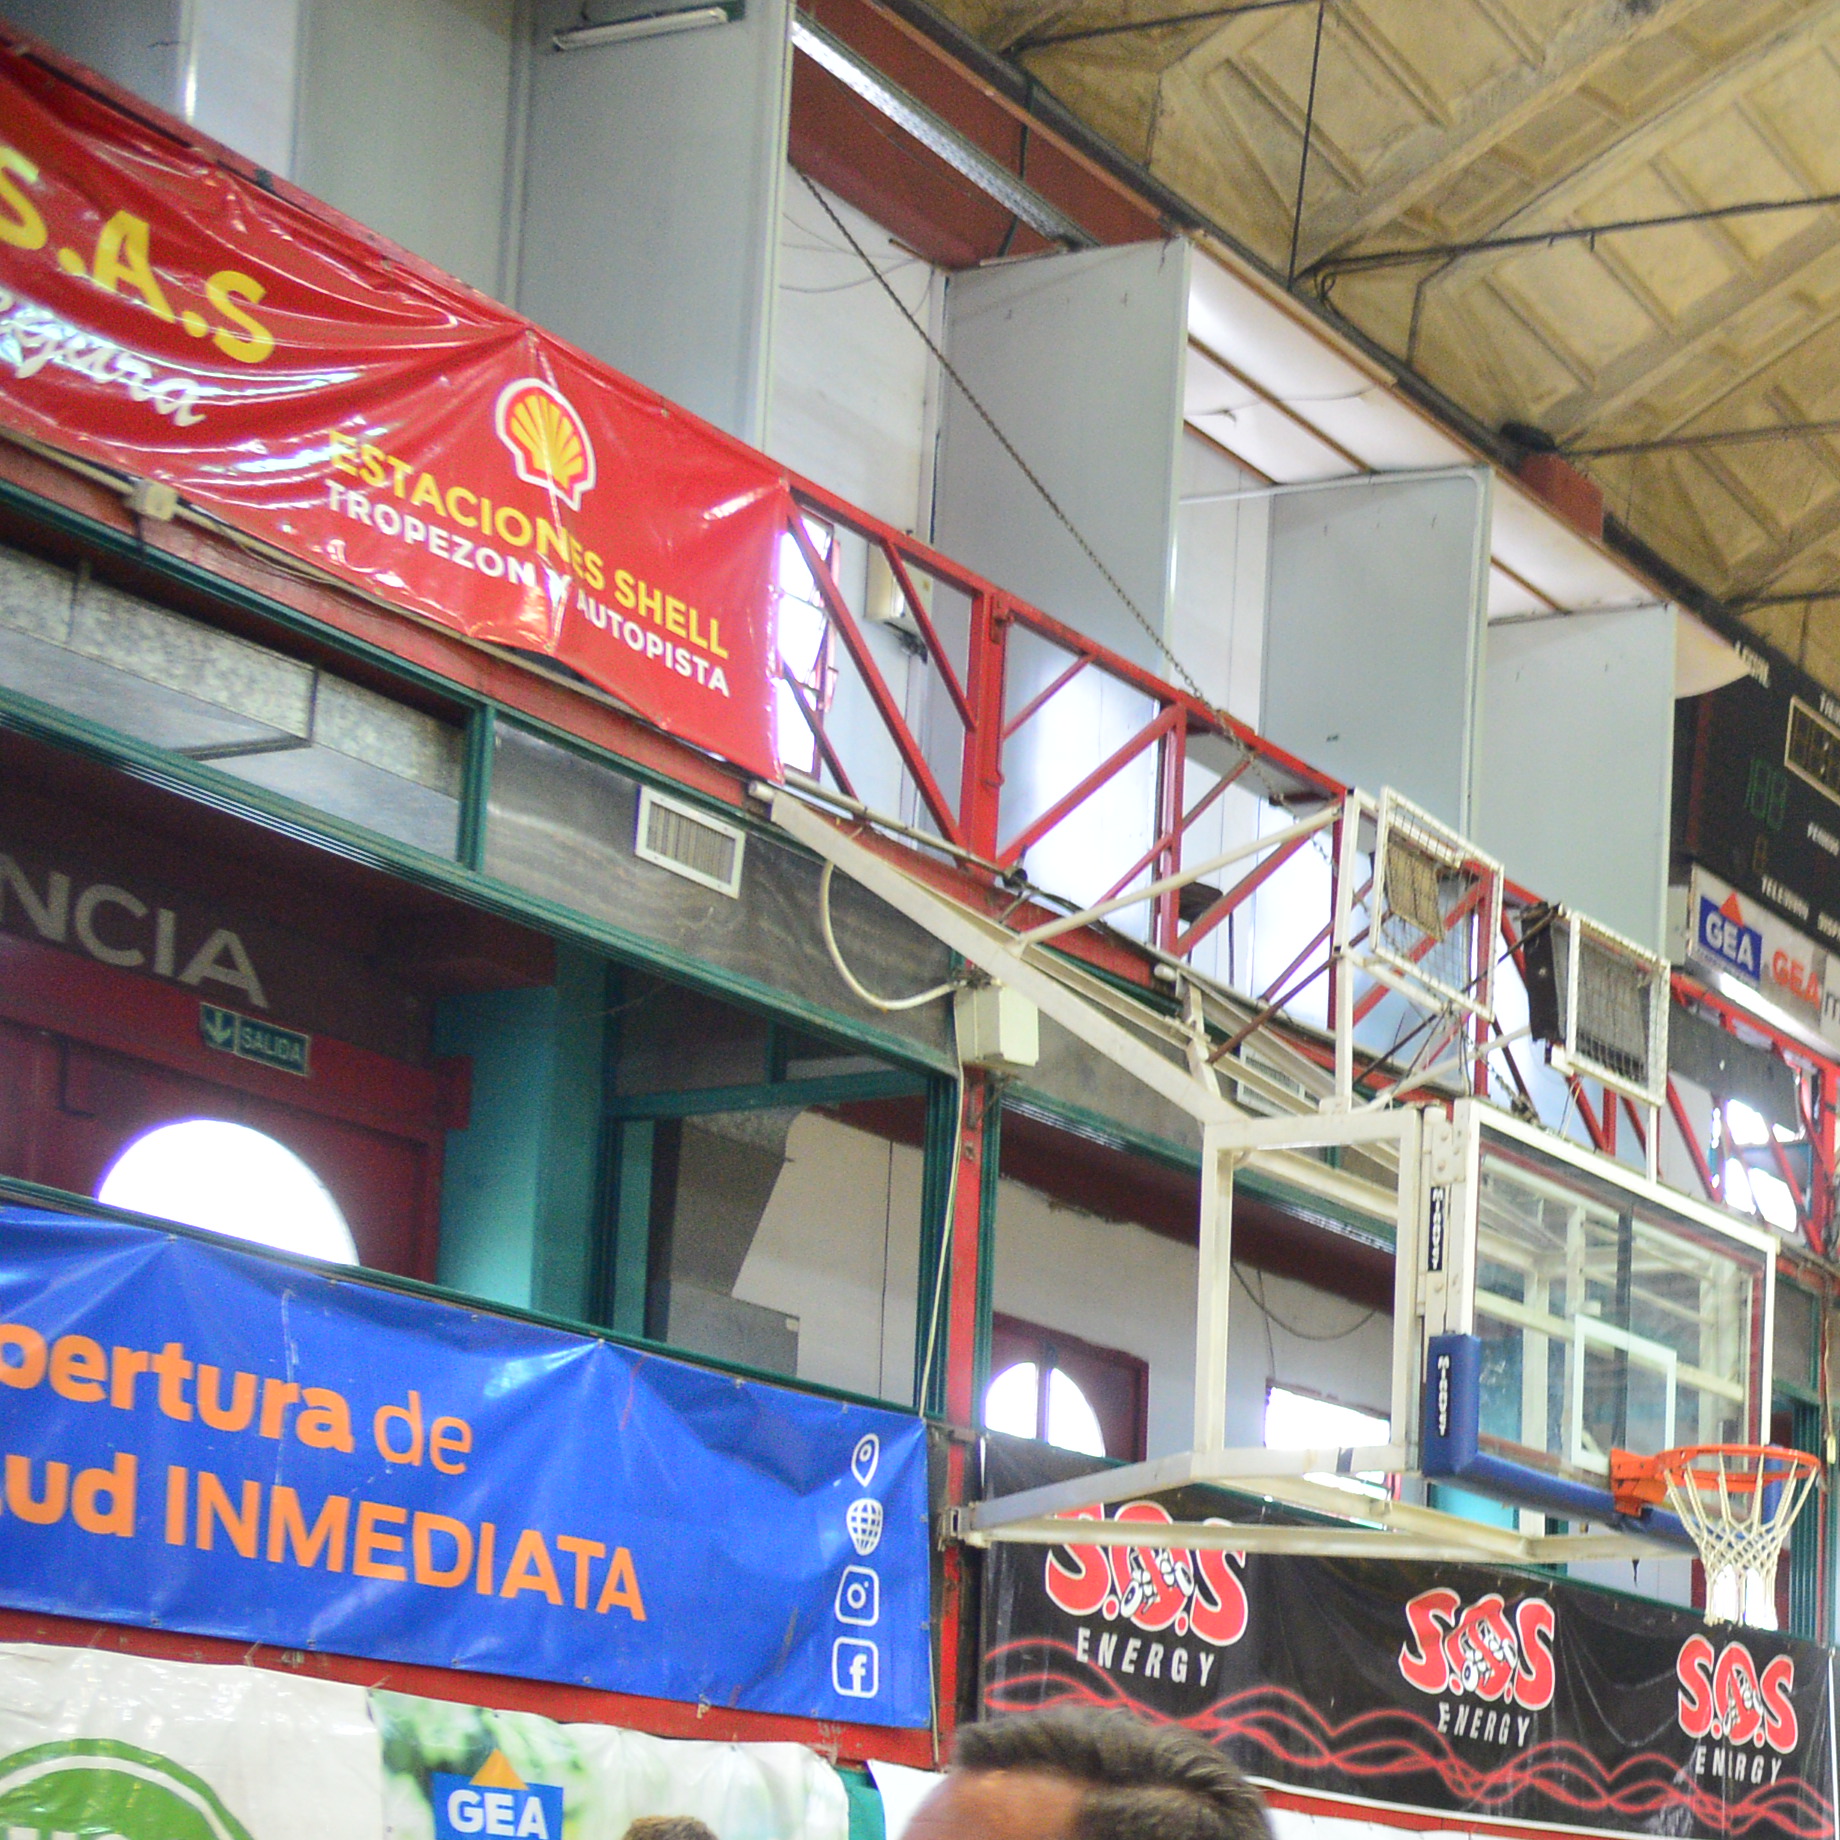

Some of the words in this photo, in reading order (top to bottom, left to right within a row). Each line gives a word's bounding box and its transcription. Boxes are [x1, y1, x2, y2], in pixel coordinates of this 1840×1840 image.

[329, 430, 606, 591] ESTACIONES
[613, 569, 730, 660] SHELL
[324, 478, 537, 588] TROPEZON
[576, 590, 730, 698] AUTOPISTA
[1705, 910, 1755, 972] GEA
[242, 1026, 302, 1063] SALIDA
[373, 1389, 474, 1476] de
[0, 1452, 138, 1538] ud
[165, 1464, 647, 1622] INMEDIATA
[1076, 1626, 1216, 1688] ENERGY
[1436, 1702, 1531, 1748] ENERGY
[447, 1789, 549, 1840] GEA
